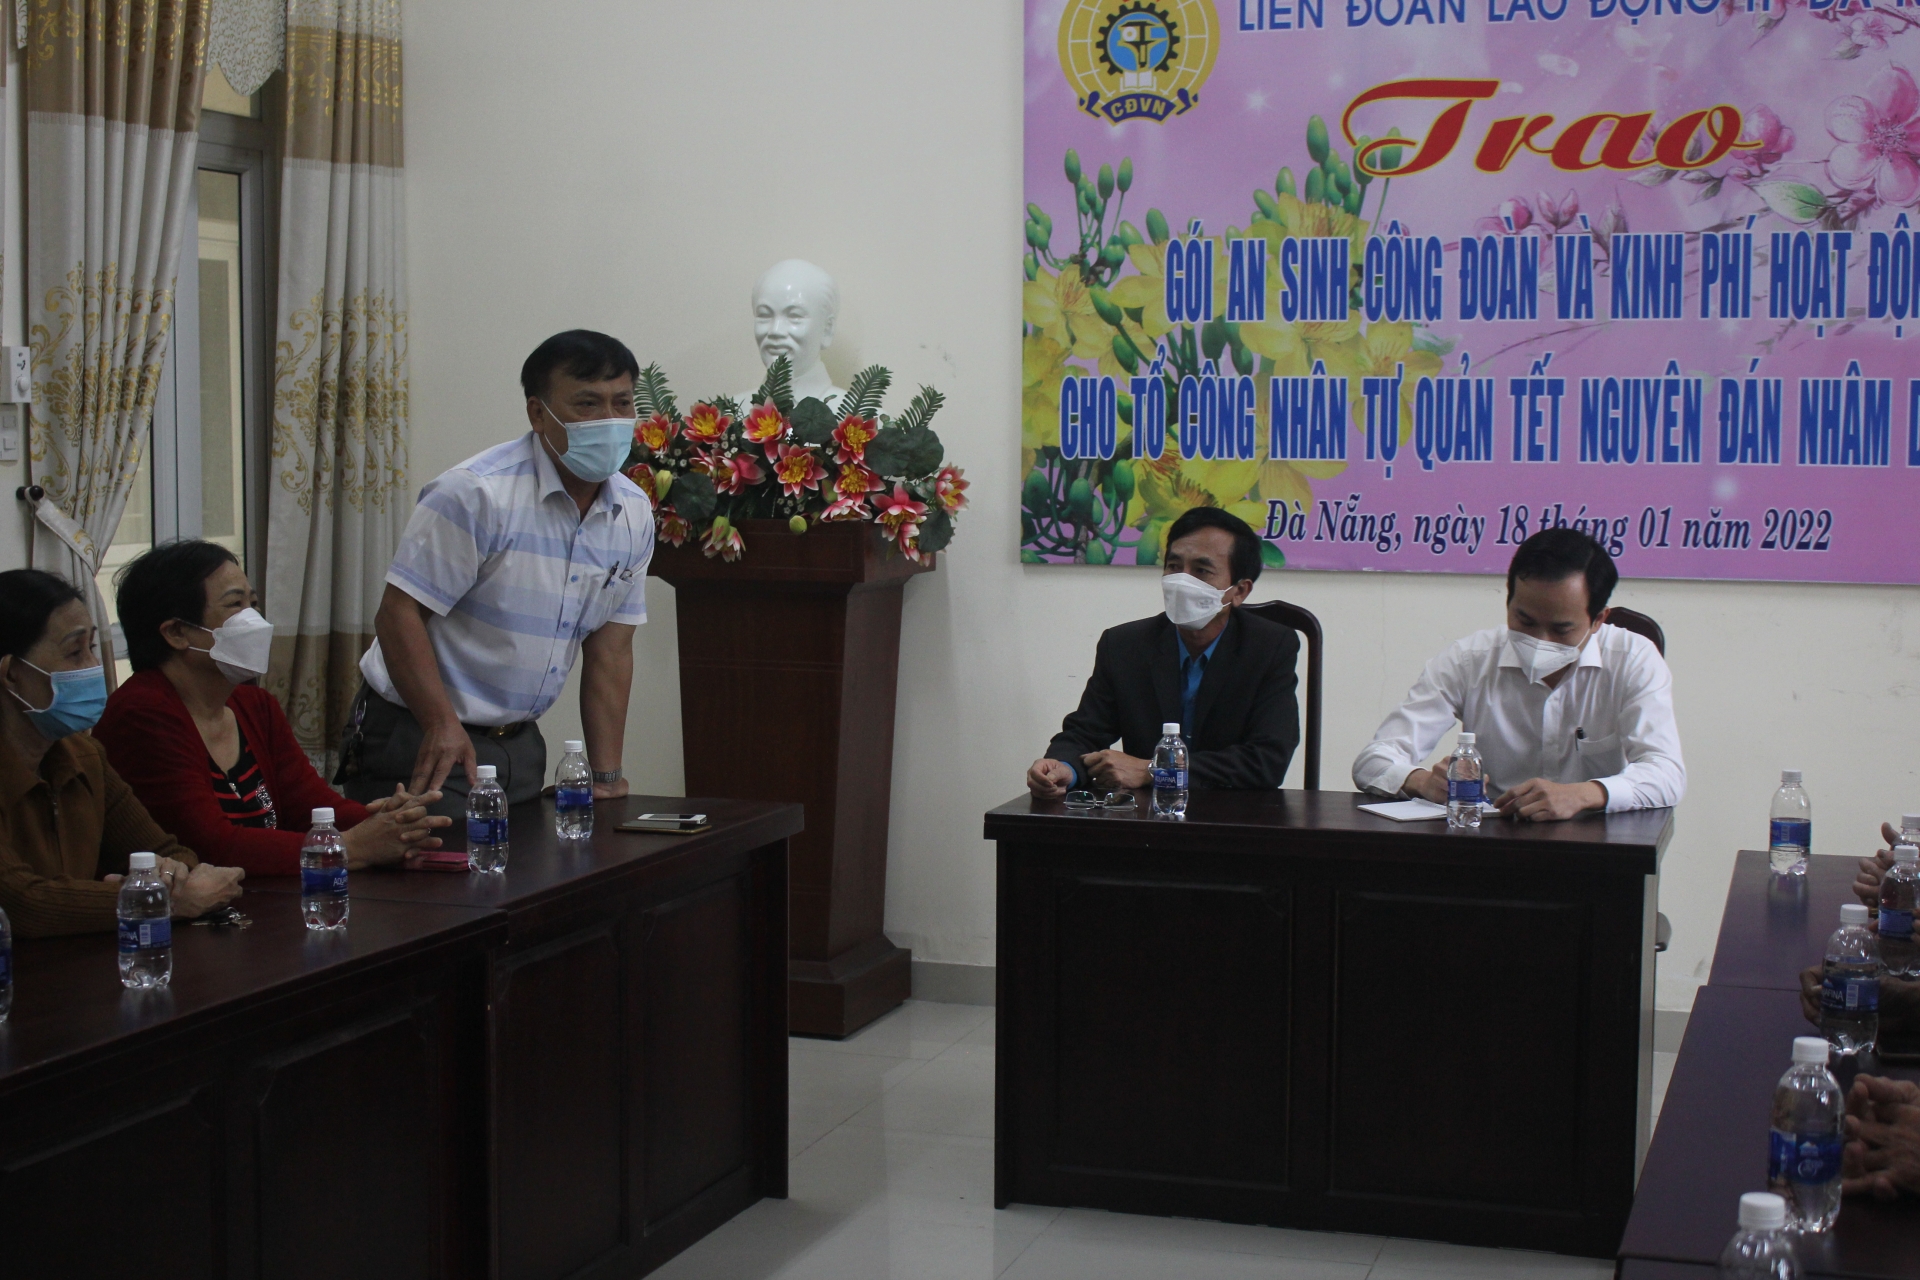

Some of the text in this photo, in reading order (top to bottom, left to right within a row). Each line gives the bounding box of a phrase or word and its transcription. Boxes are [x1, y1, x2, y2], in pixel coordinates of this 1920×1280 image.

[1110, 97, 1166, 118] CĐVN
[1341, 79, 1763, 176] Trao
[1167, 222, 1213, 322] GÓI
[1228, 239, 1266, 321] AN
[1281, 238, 1349, 321] SINH
[1365, 221, 1442, 321] CÔNG
[1459, 216, 1537, 320] ĐOÀN
[1555, 215, 1593, 319] VÀ
[1611, 234, 1684, 319] KINH
[1700, 215, 1756, 318] PHÍ
[1770, 232, 1851, 338] HOẠT
[1060, 376, 1116, 459] CHO
[1131, 345, 1166, 459] TỔ
[1179, 361, 1255, 459] CÔNG
[1270, 361, 1347, 459] NHÂN
[1363, 364, 1403, 478] TỰ
[1416, 353, 1493, 470] QUẢN
[1510, 353, 1564, 462] TẾT
[1580, 360, 1701, 463] NGUYÊN
[1719, 358, 1781, 464] ĐÁN
[1799, 361, 1890, 466] NHÂM
[1265, 495, 1832, 557] Đà Nẵng, ngày 18 tháng 01 năm 2022
